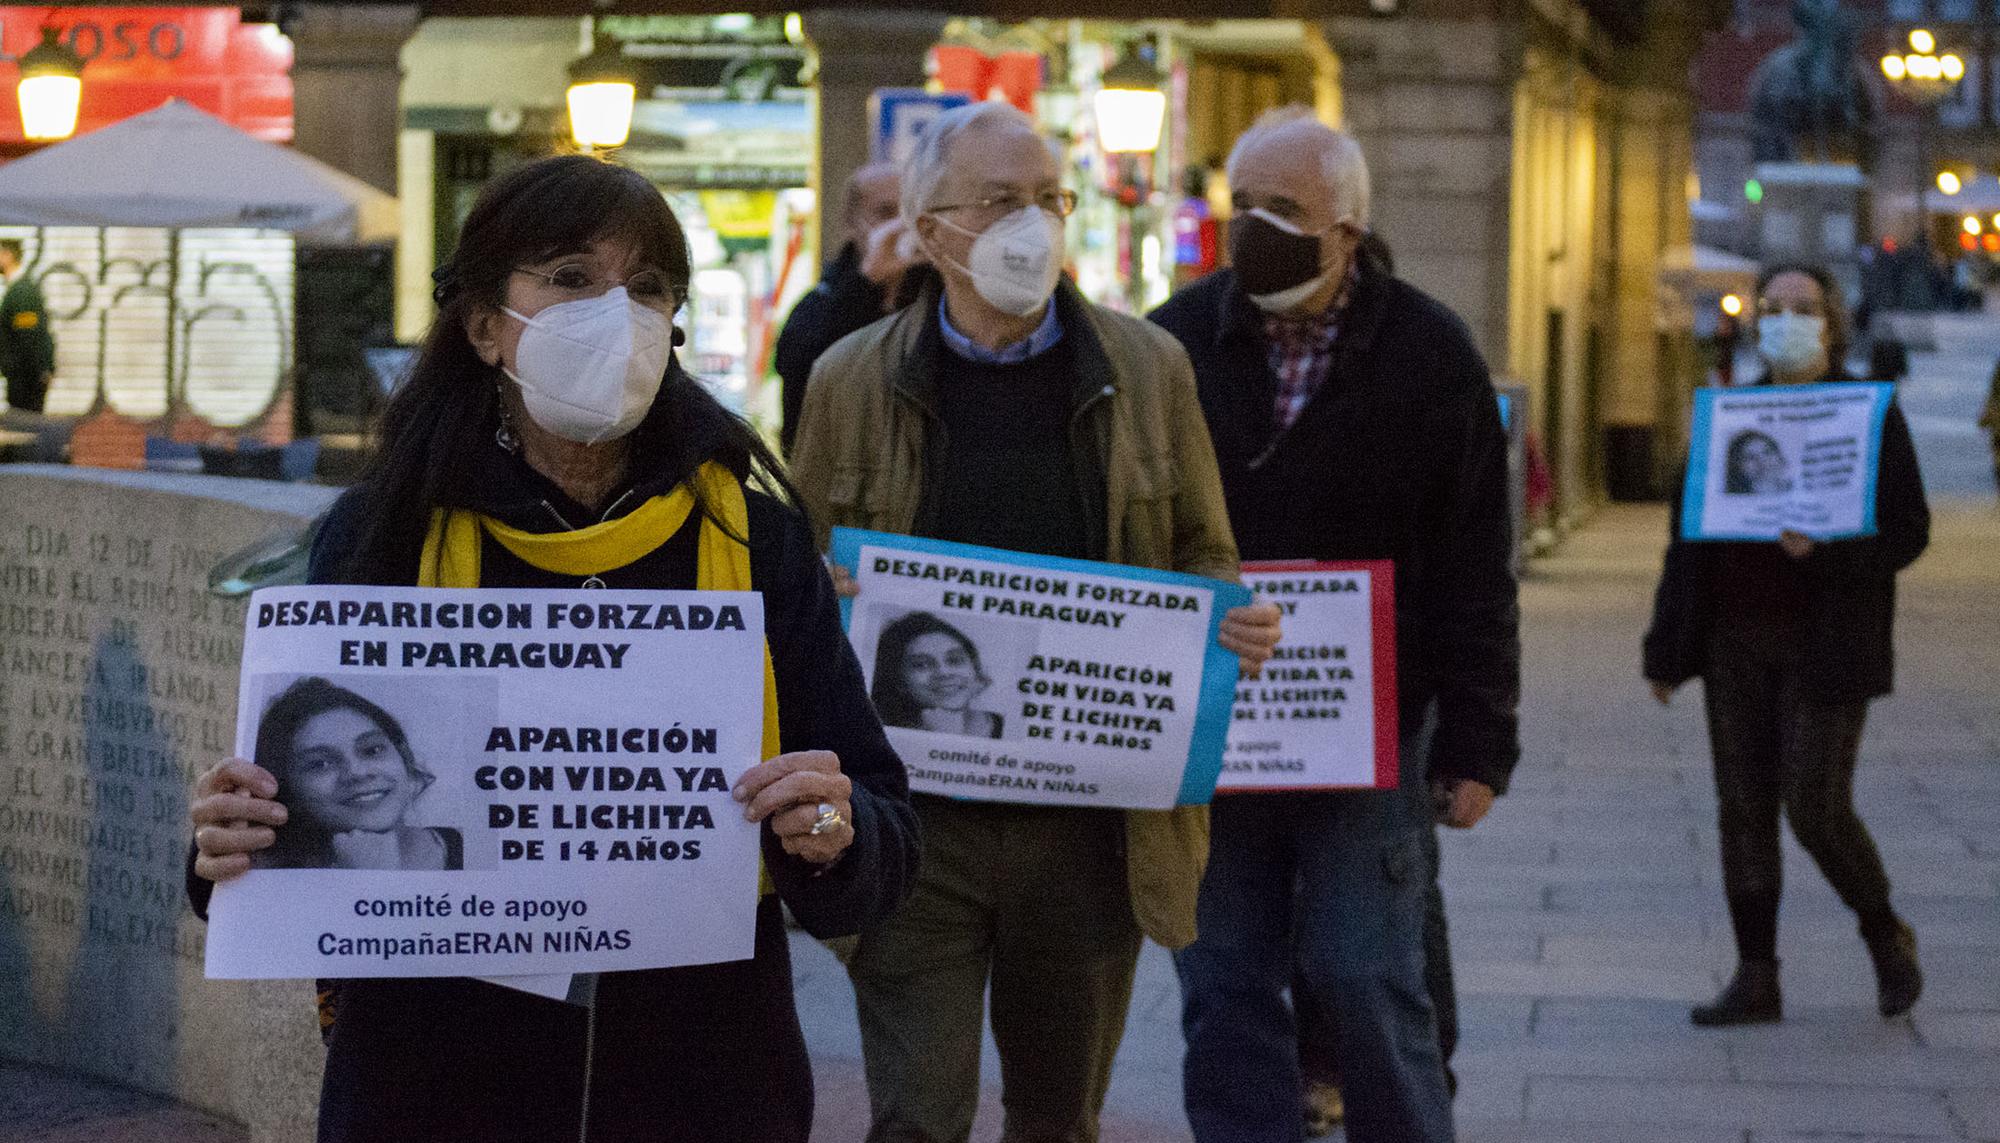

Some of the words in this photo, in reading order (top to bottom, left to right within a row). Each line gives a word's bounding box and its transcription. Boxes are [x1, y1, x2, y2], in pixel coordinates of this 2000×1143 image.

[71, 570, 99, 603] EL
[872, 556, 1069, 598] DESAPARICION
[1076, 582, 1200, 613] FORZADA
[257, 600, 532, 629] DESAPARICION
[547, 603, 746, 632] FORZADA
[942, 590, 974, 610] EN
[982, 595, 1126, 629] PARAGUAY
[339, 640, 388, 667] EN
[401, 642, 631, 669] PARAGUAY
[1017, 676, 1069, 699] CON
[1074, 683, 1136, 708] VIDA
[1143, 692, 1176, 713] YA
[1022, 702, 1056, 721] DE
[1062, 706, 1164, 734] LICHITA
[1027, 724, 1055, 740] DE
[1062, 728, 1089, 743] 14
[484, 722, 717, 754] APARICIÓN
[14, 766, 43, 798] EL
[474, 766, 554, 791] CON
[564, 766, 667, 792] VIDA
[673, 767, 730, 792] YA
[488, 804, 539, 829] DE
[552, 804, 715, 830] LICHITA
[502, 840, 544, 861] DE
[560, 840, 599, 861] 14
[607, 836, 701, 861] AÑOS
[353, 893, 452, 918] comité
[461, 894, 495, 917] de
[504, 899, 588, 922] apoyo
[317, 932, 533, 961] CampañaERAN
[543, 926, 631, 953] NIÑAS
